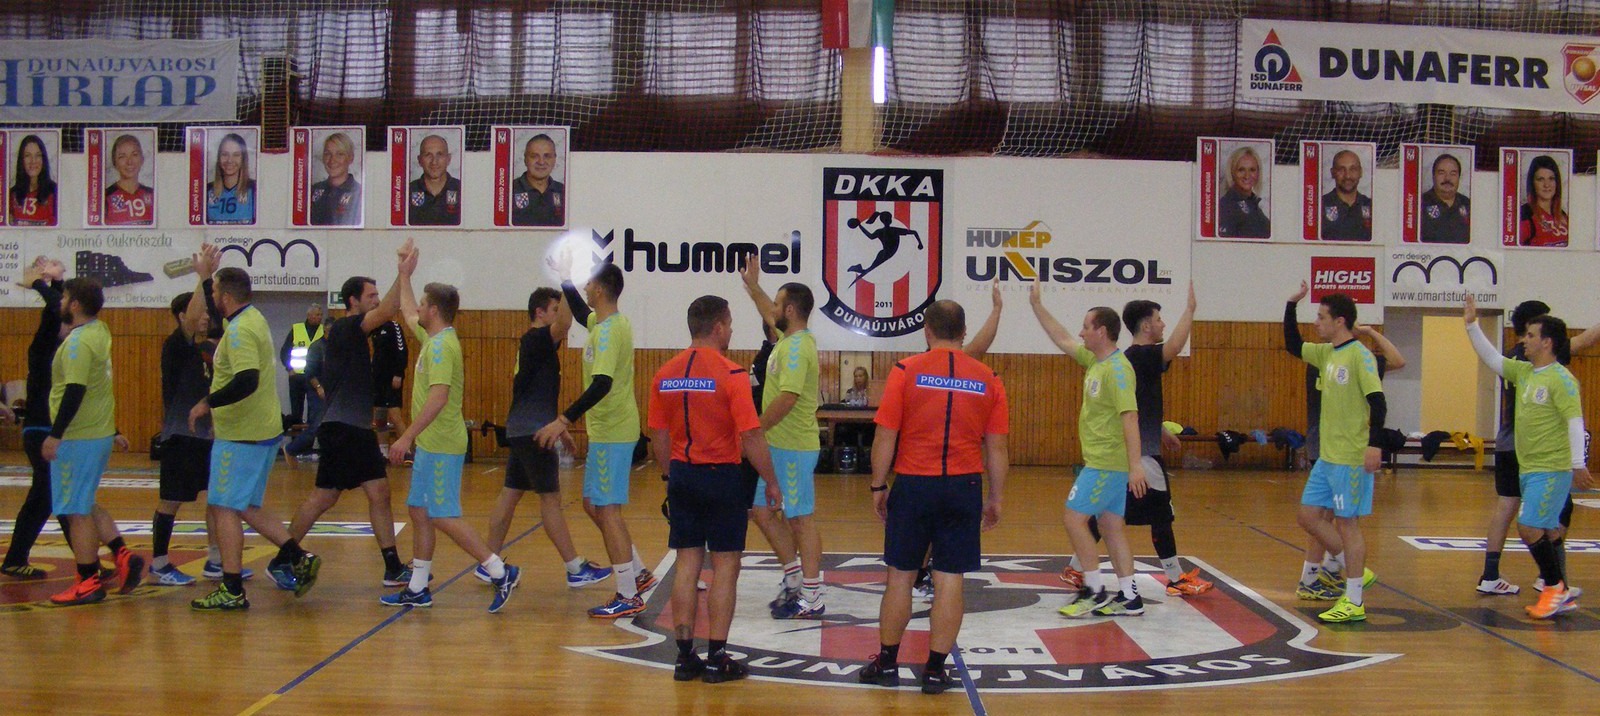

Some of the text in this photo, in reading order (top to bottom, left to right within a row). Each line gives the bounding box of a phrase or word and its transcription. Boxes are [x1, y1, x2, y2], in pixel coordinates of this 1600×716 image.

[28, 56, 217, 73] DUNAÚJVÁROSI
[1319, 47, 1550, 89] DUNAFERR
[1250, 73, 1267, 81] ISD
[1250, 82, 1303, 91] DUNAFERR
[833, 174, 935, 197] DKKA
[23, 197, 38, 215] 13
[125, 199, 146, 217] 19
[220, 197, 237, 214] 16
[190, 214, 200, 222] 16
[57, 233, 173, 248] Dominó Cukrászda
[228, 236, 253, 247] design
[966, 230, 1052, 249] HUNEP
[1504, 234, 1514, 242] 33
[624, 228, 801, 274] hummel
[966, 252, 1172, 284] UNISZOL
[1315, 270, 1372, 284] HIGH5
[834, 306, 927, 332] DUNAÚJVÁRO
[662, 379, 713, 389] PROVIDENT
[920, 375, 984, 392] PROVIDENT
[1333, 494, 1344, 510] 11
